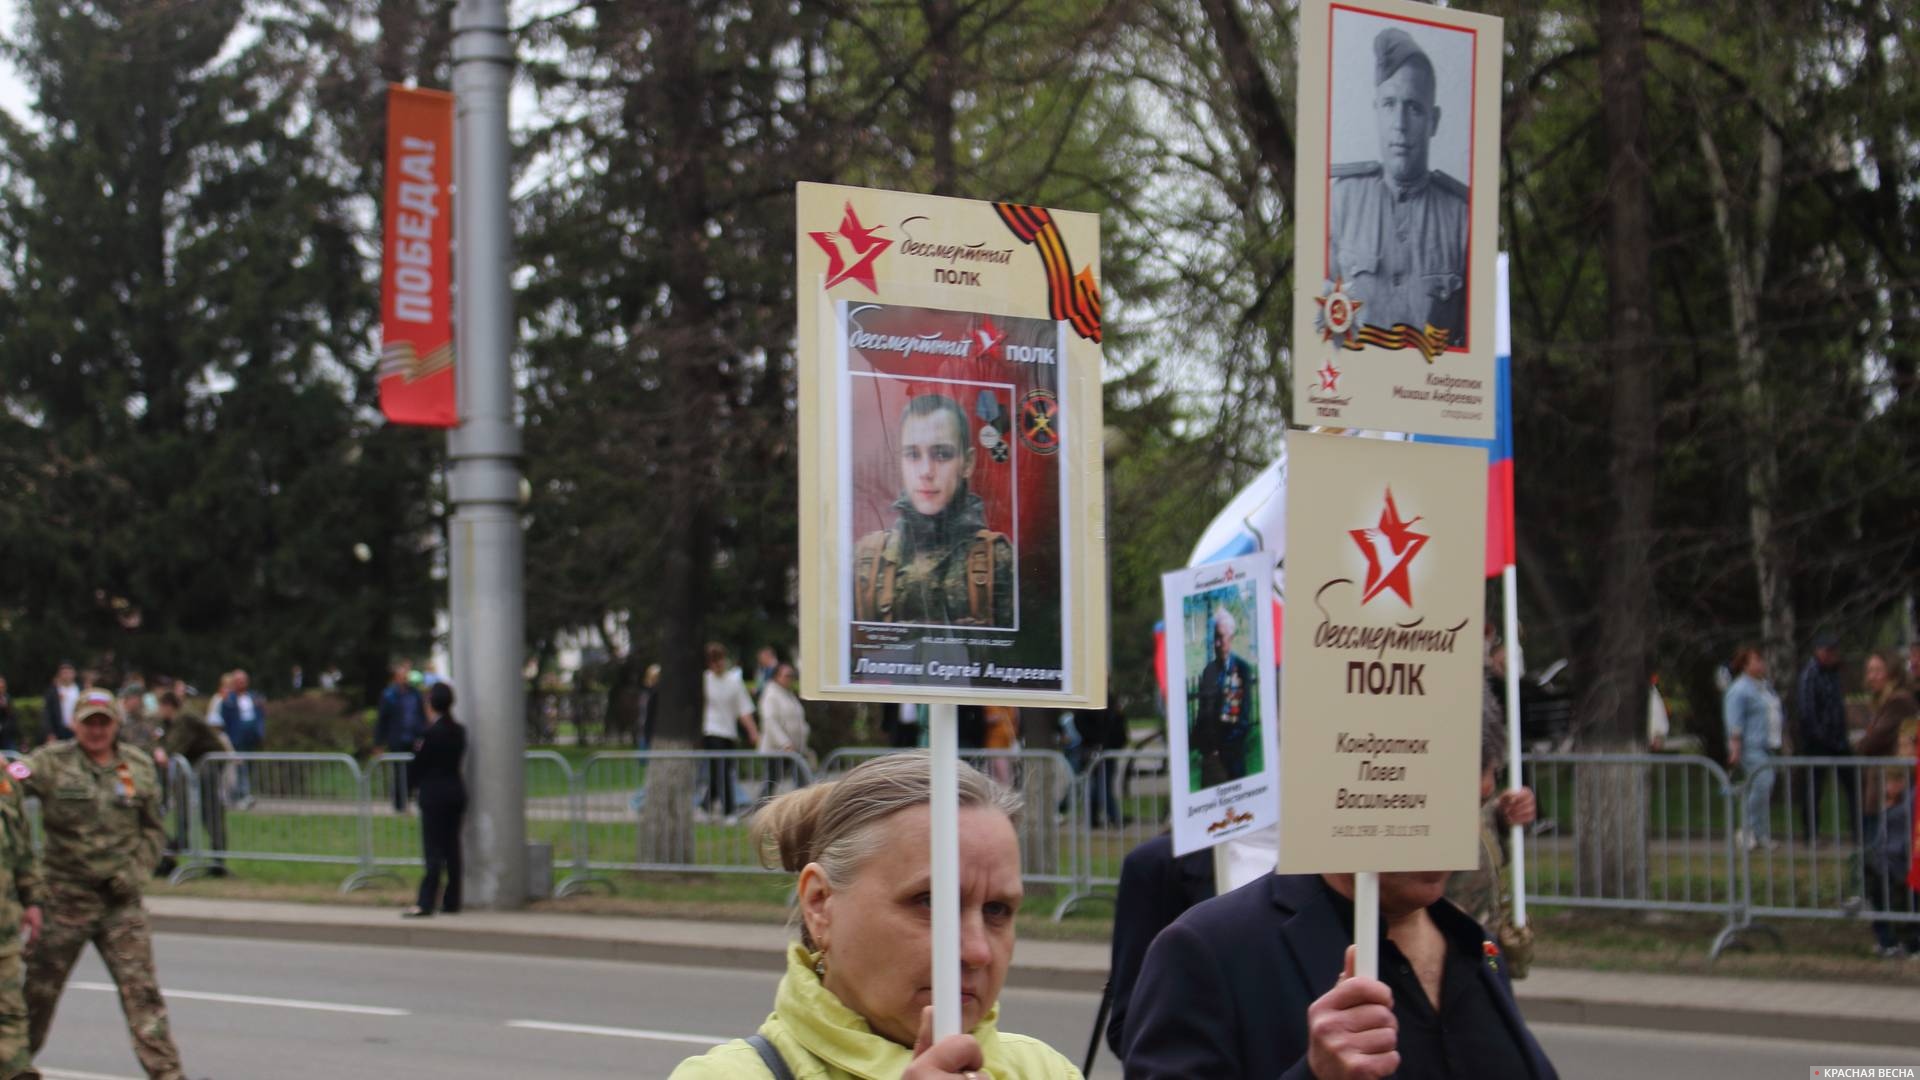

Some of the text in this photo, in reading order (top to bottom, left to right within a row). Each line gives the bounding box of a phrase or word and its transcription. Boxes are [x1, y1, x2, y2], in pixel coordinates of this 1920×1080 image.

[394, 137, 439, 323] ПОБЕДА!
[900, 216, 1013, 265] бессмертный
[934, 269, 981, 287] ПОЛК
[849, 305, 1056, 365] бессмертный ПОЛК
[1314, 578, 1469, 659] бессмертный
[854, 658, 925, 675] Лопатин
[928, 661, 981, 680] Сергей
[1347, 661, 1426, 696] ПОЛК
[1335, 733, 1429, 758] Кондратюк
[1358, 761, 1406, 781] Павел
[1335, 788, 1427, 809] Васильевич
